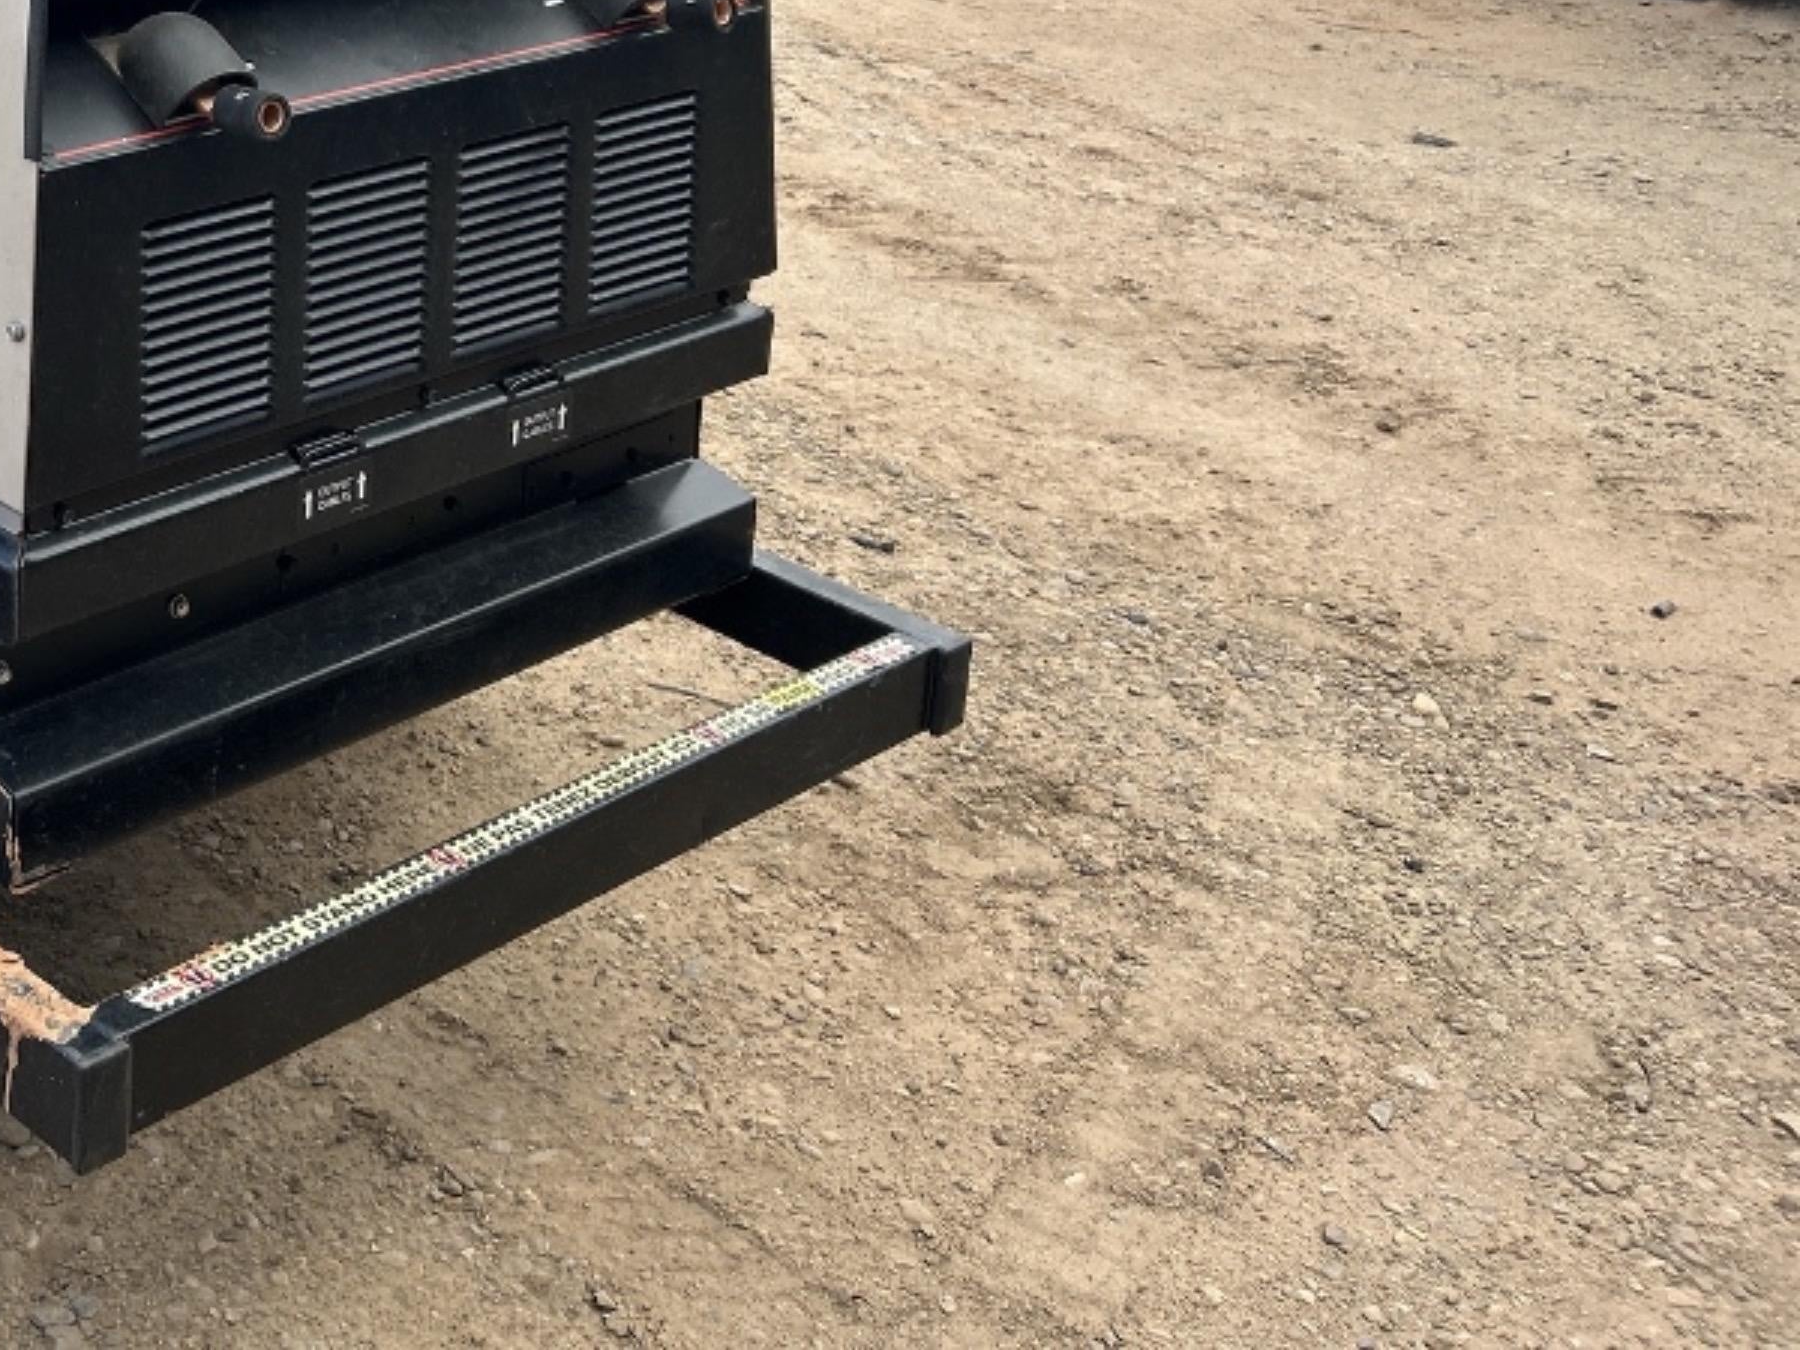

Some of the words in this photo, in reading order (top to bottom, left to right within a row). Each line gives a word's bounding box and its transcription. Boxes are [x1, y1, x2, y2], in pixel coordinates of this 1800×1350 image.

[210, 947, 251, 975] DO
[253, 925, 301, 956] NOT
[301, 885, 377, 930] STAND
[376, 861, 433, 895] HERE
